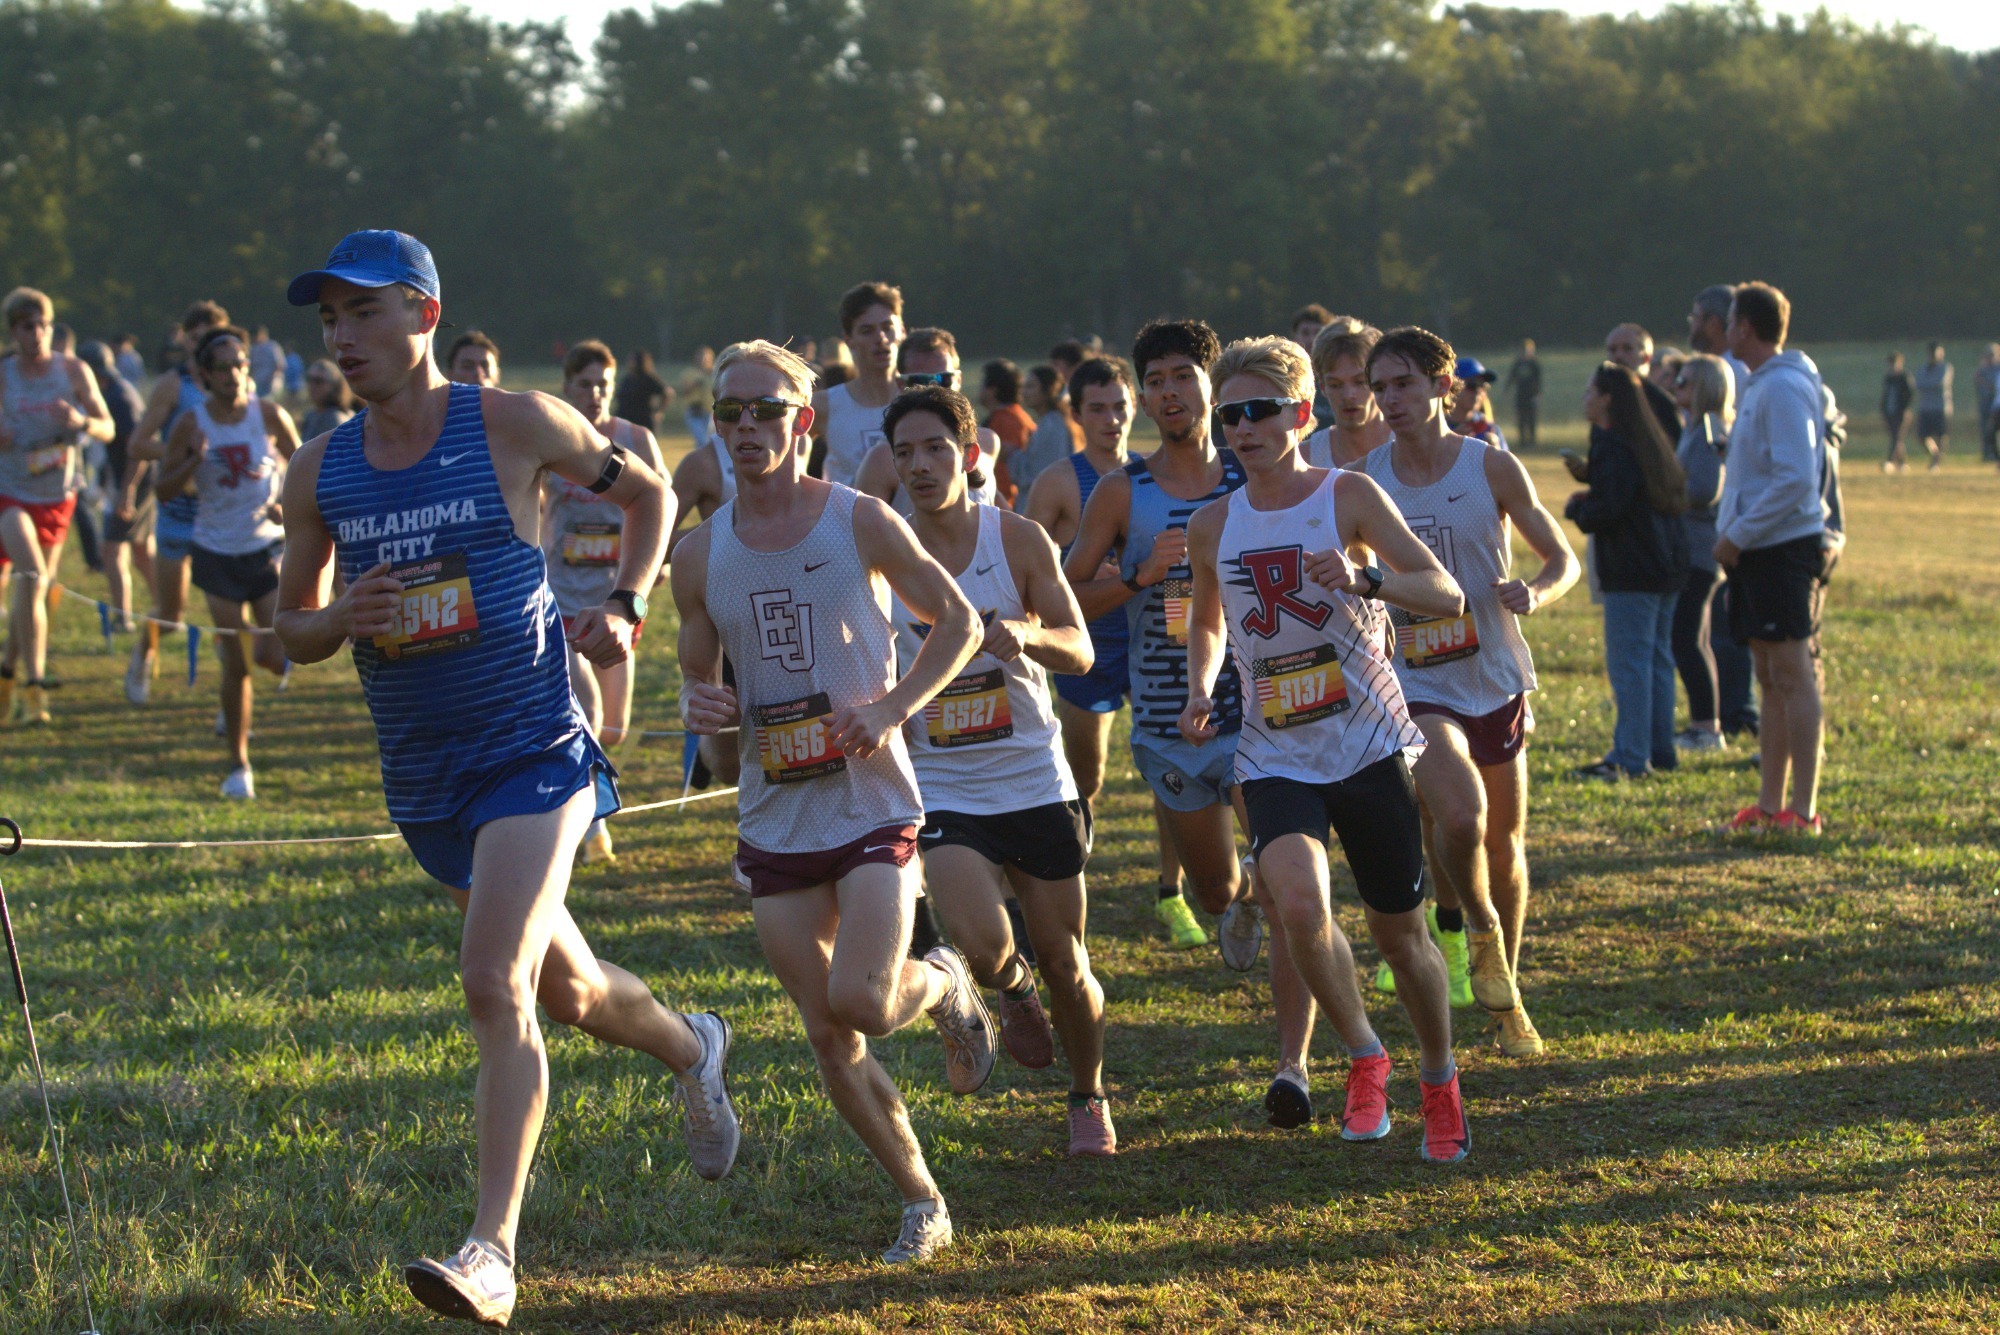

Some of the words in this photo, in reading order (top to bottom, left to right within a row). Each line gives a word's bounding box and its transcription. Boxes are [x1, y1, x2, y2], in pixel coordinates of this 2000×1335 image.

[338, 499, 478, 543] OKLAHOMA
[378, 533, 437, 564] CITY
[1239, 543, 1334, 640] R
[1415, 619, 1466, 653] 6449
[1279, 670, 1328, 710] 5137
[943, 695, 997, 731] 6527
[769, 722, 826, 765] 6456
